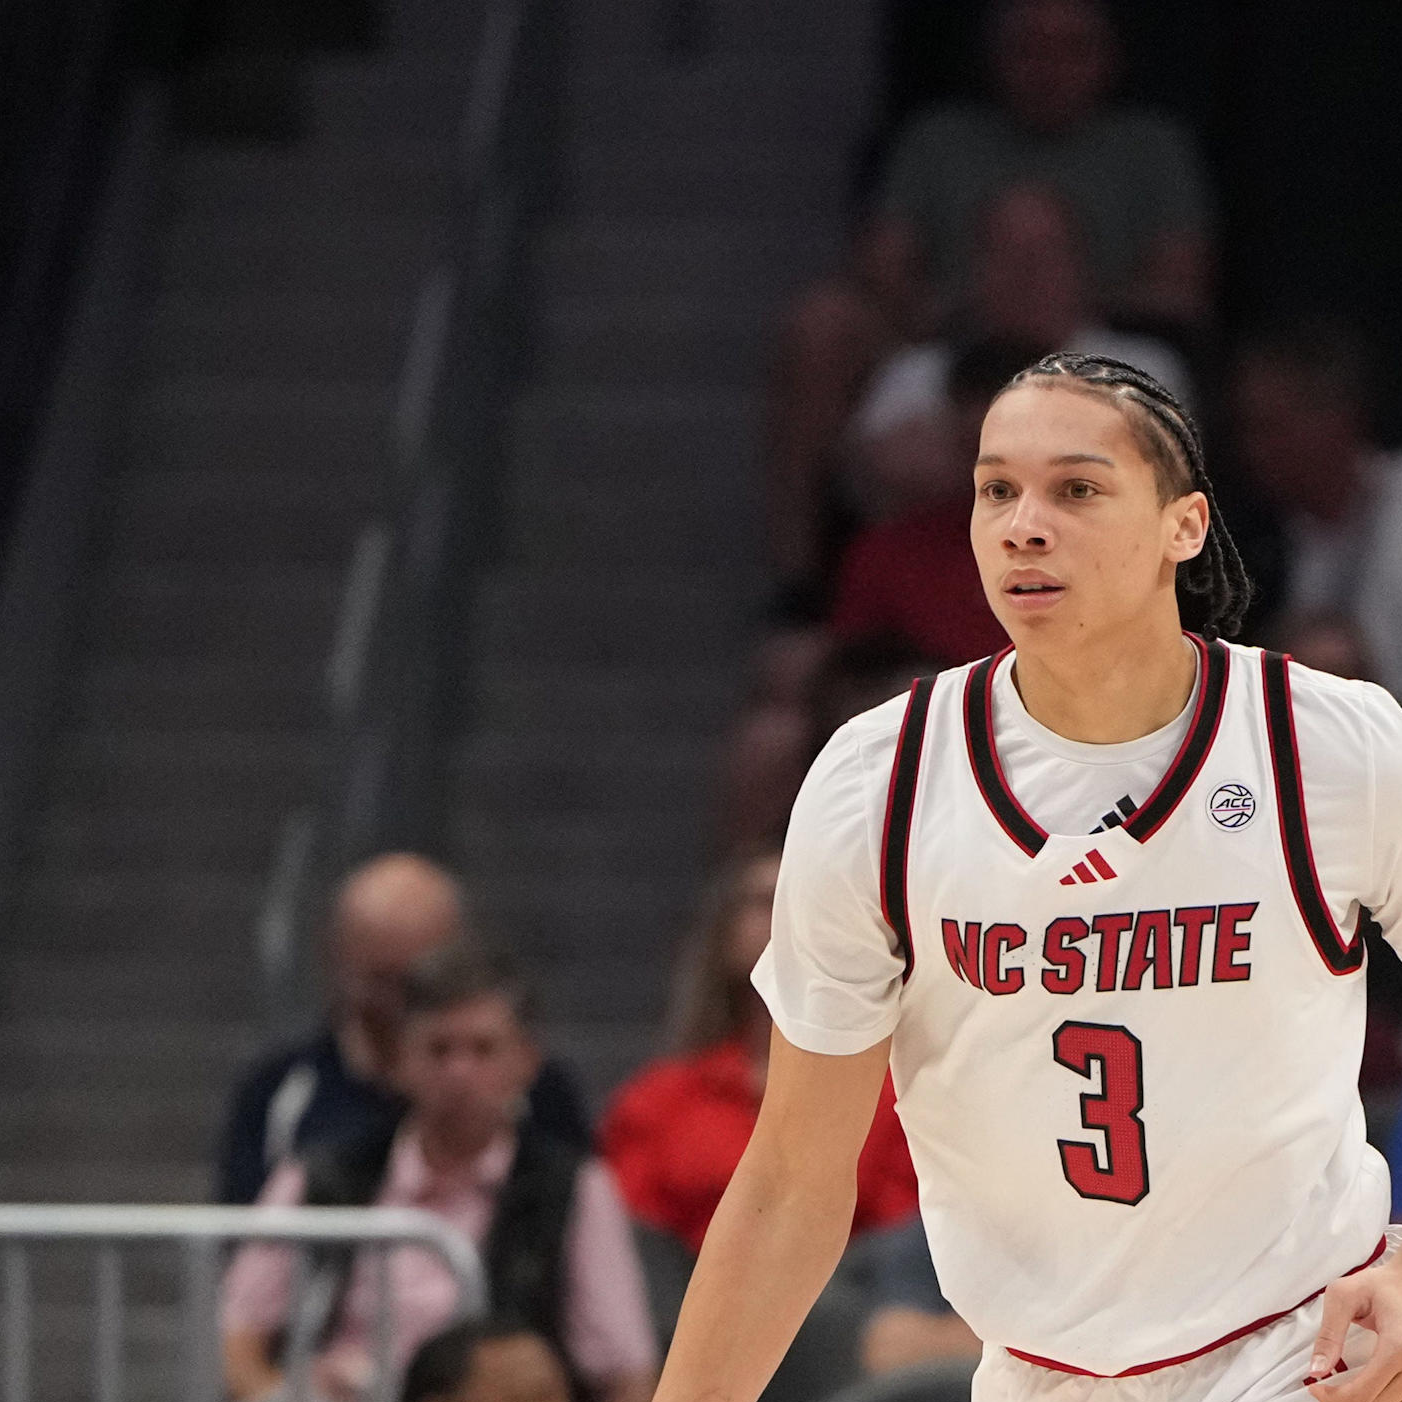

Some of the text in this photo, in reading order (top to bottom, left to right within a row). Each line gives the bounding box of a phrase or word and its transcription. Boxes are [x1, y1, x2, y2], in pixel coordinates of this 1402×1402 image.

[1215, 797, 1253, 809] ACC
[940, 902, 1261, 996] NC STATE
[1053, 1020, 1150, 1206] 3
